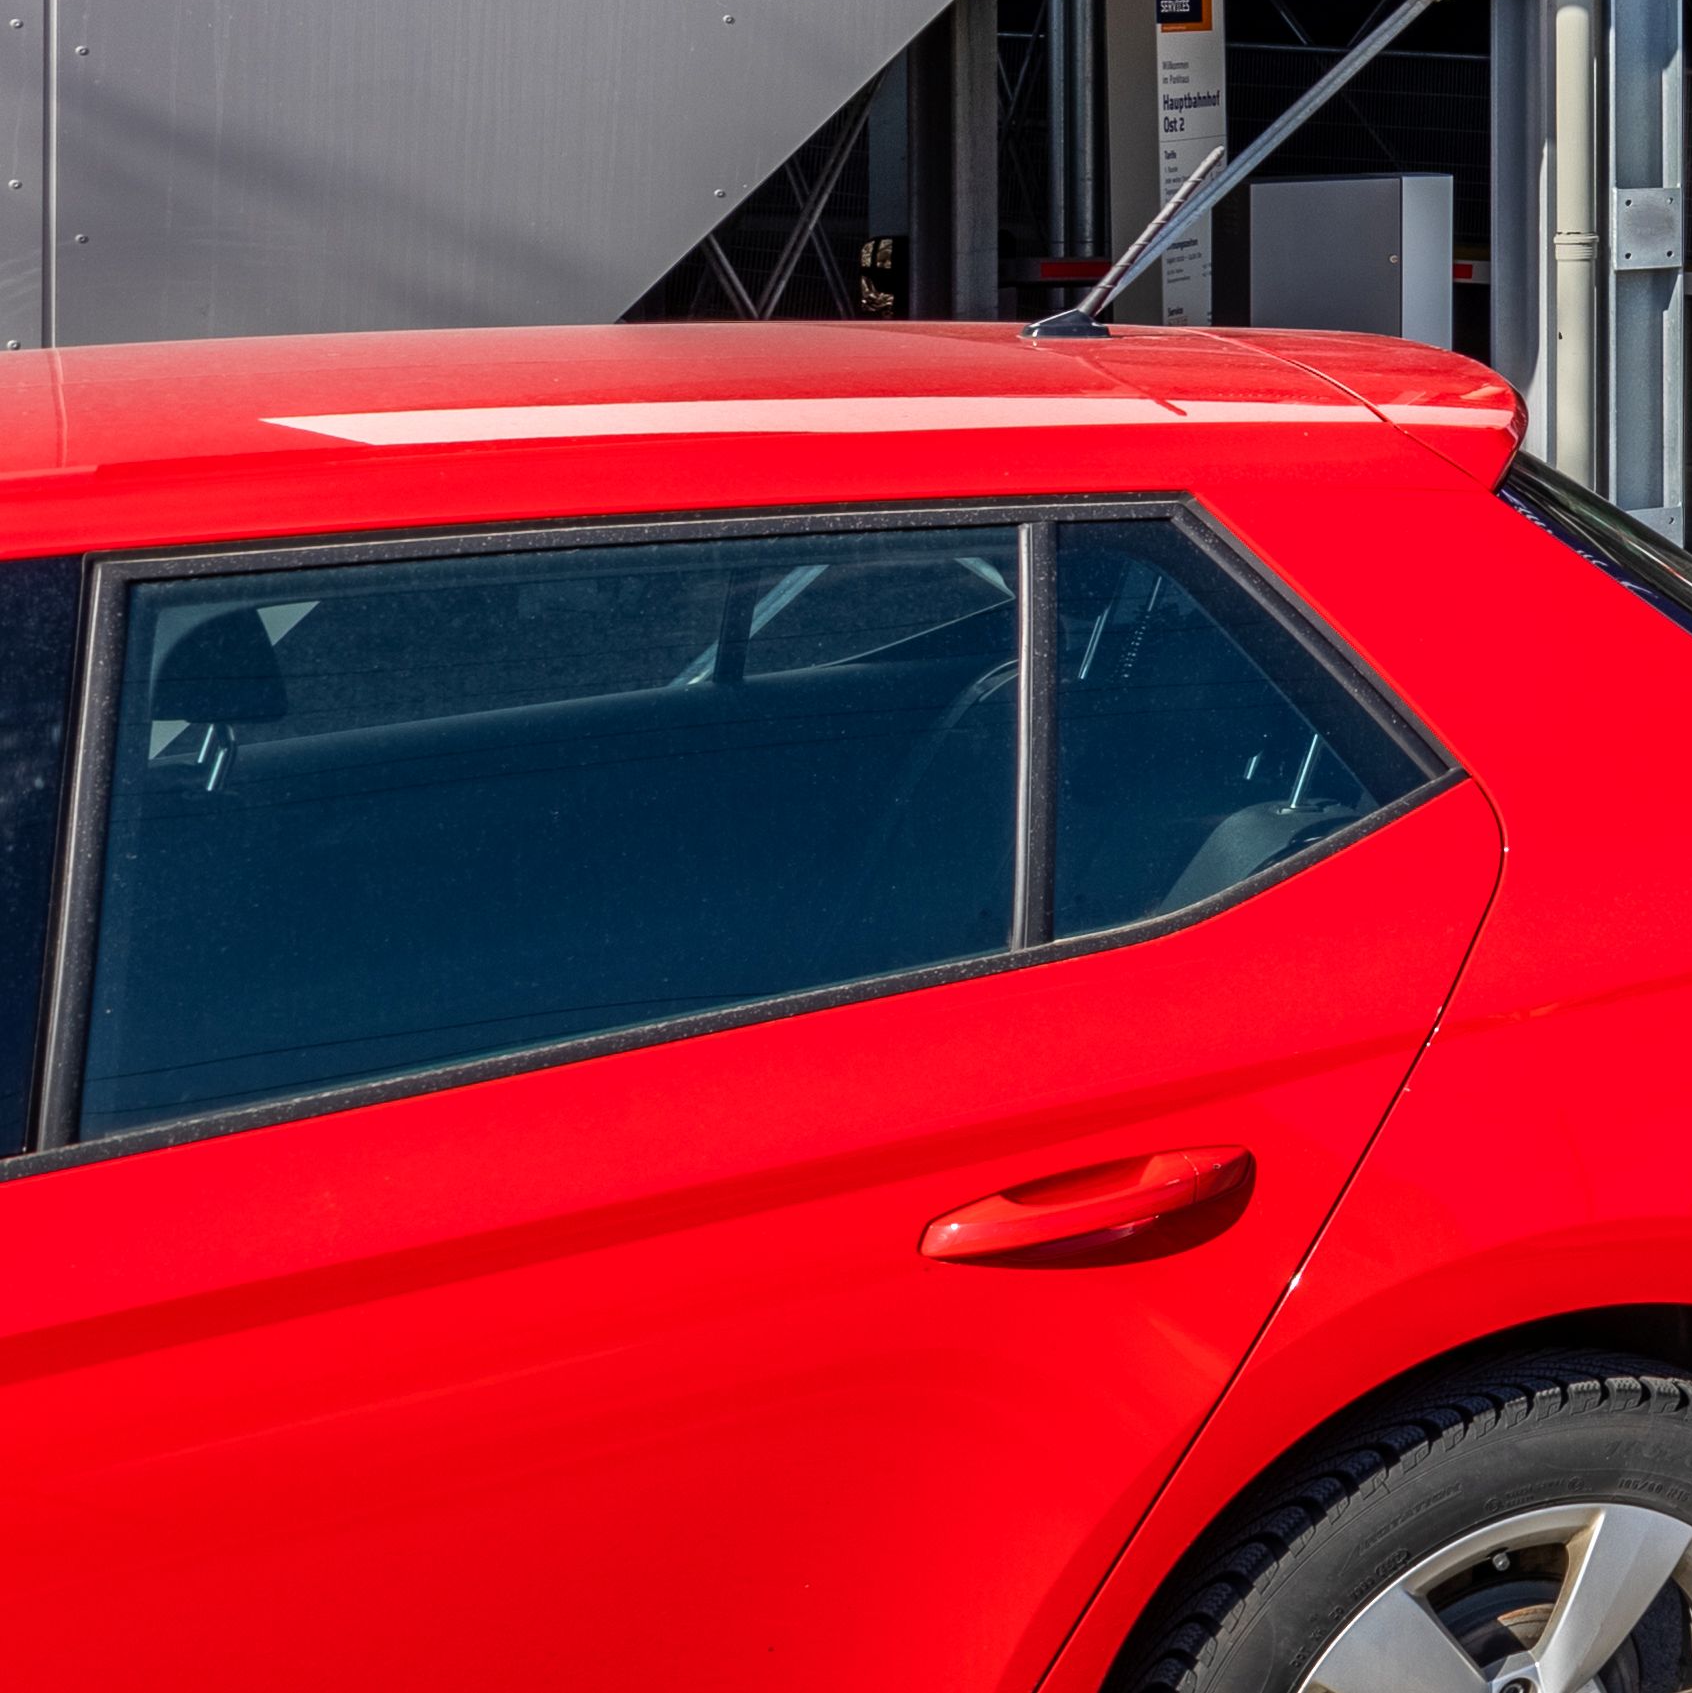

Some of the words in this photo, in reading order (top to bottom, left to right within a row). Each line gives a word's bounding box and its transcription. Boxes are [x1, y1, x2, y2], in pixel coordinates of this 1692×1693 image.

[1160, 0, 1191, 13] SERVICES
[1163, 89, 1221, 114] Hauptbahnhof
[1163, 116, 1179, 134] Ost
[1179, 117, 1186, 133] 2
